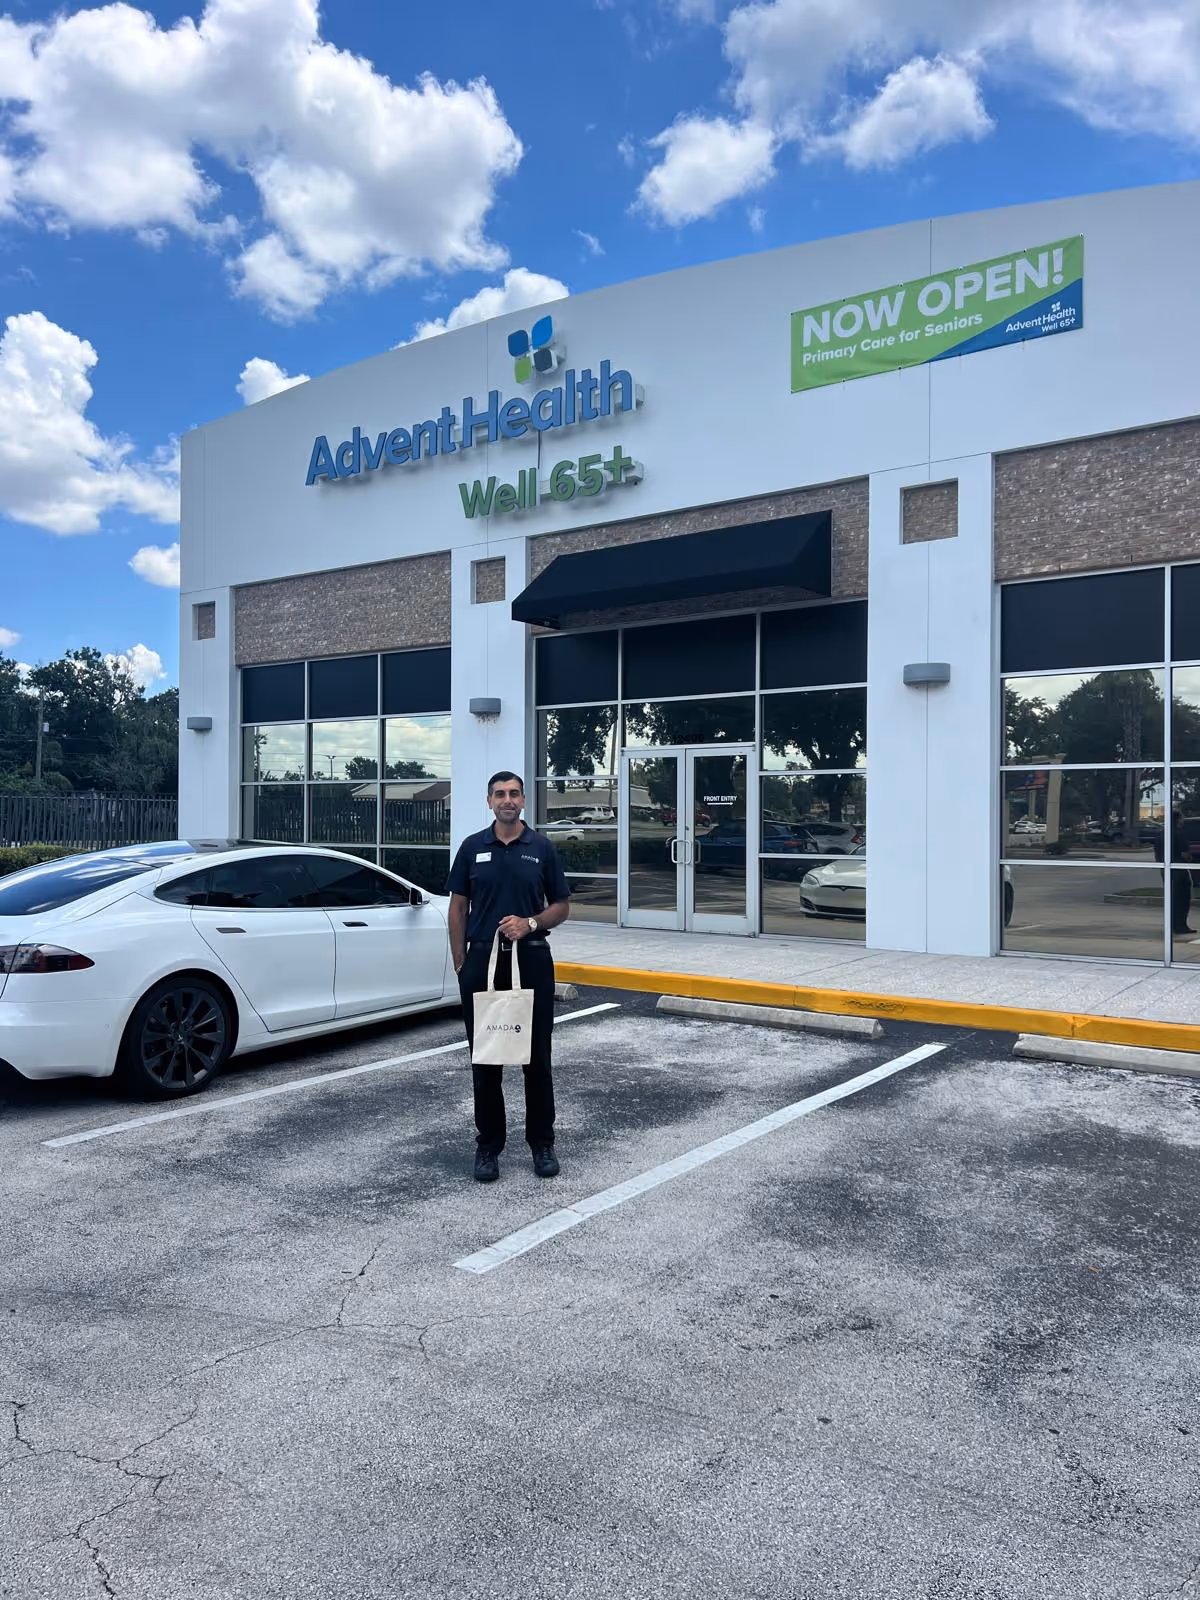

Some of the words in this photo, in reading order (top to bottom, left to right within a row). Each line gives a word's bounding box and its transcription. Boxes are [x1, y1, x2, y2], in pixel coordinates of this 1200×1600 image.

[802, 290, 906, 347] NOW
[917, 247, 1063, 317] OPEN!
[1041, 322, 1058, 332] Well
[1059, 317, 1076, 328] 65+
[802, 344, 857, 366] Primary
[860, 335, 895, 352] Care
[899, 328, 921, 344] for
[924, 312, 983, 338] Seniors
[305, 359, 633, 486] AdventHealth
[458, 467, 537, 519] Well
[550, 445, 633, 501] 65+
